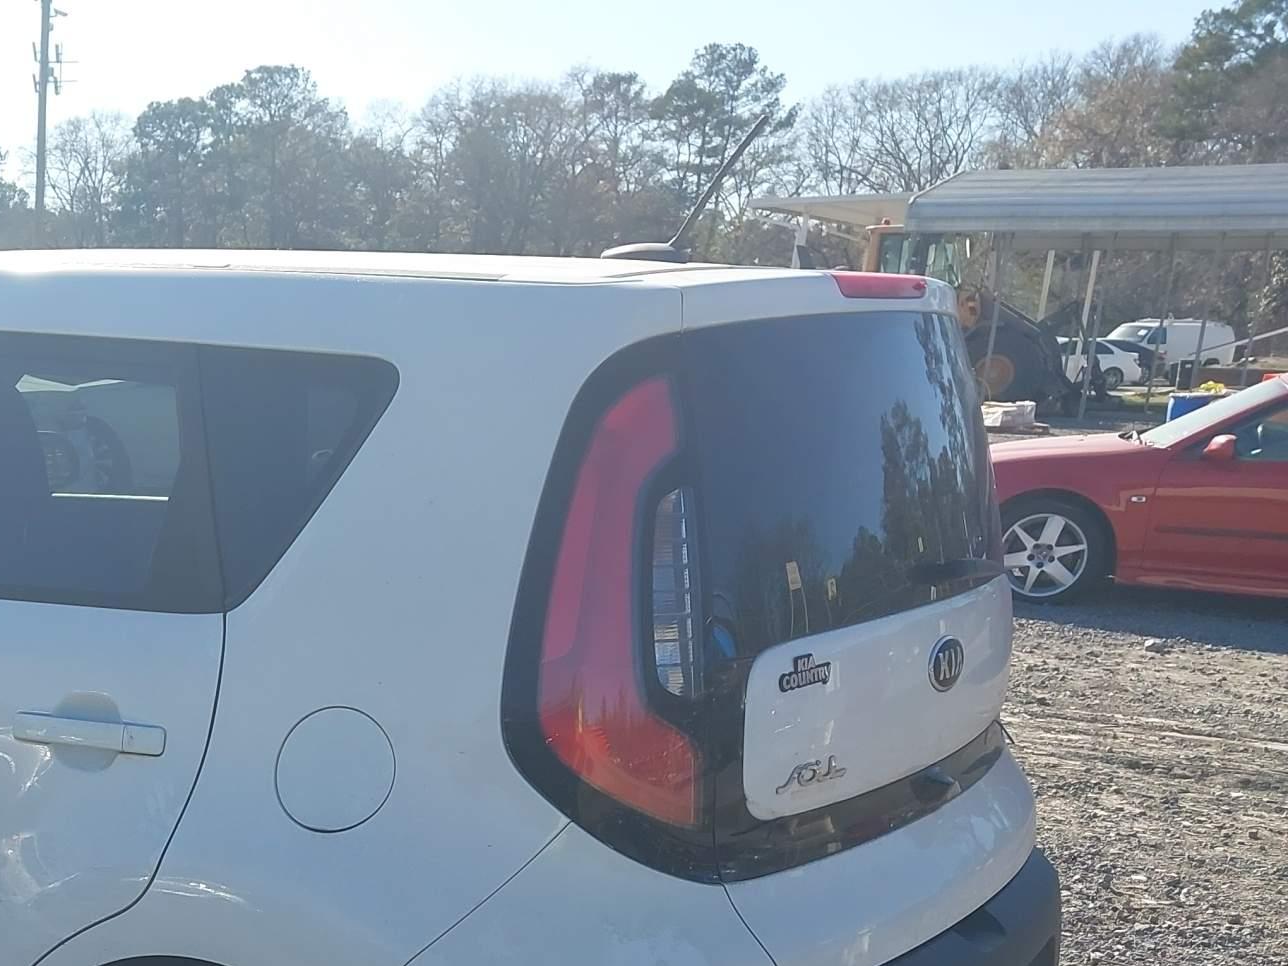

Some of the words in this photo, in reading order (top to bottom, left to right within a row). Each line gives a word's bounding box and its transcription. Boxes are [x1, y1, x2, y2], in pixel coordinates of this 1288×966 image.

[797, 656, 816, 672] KIA
[938, 644, 964, 681] KIA
[782, 664, 831, 689] COUNTRY
